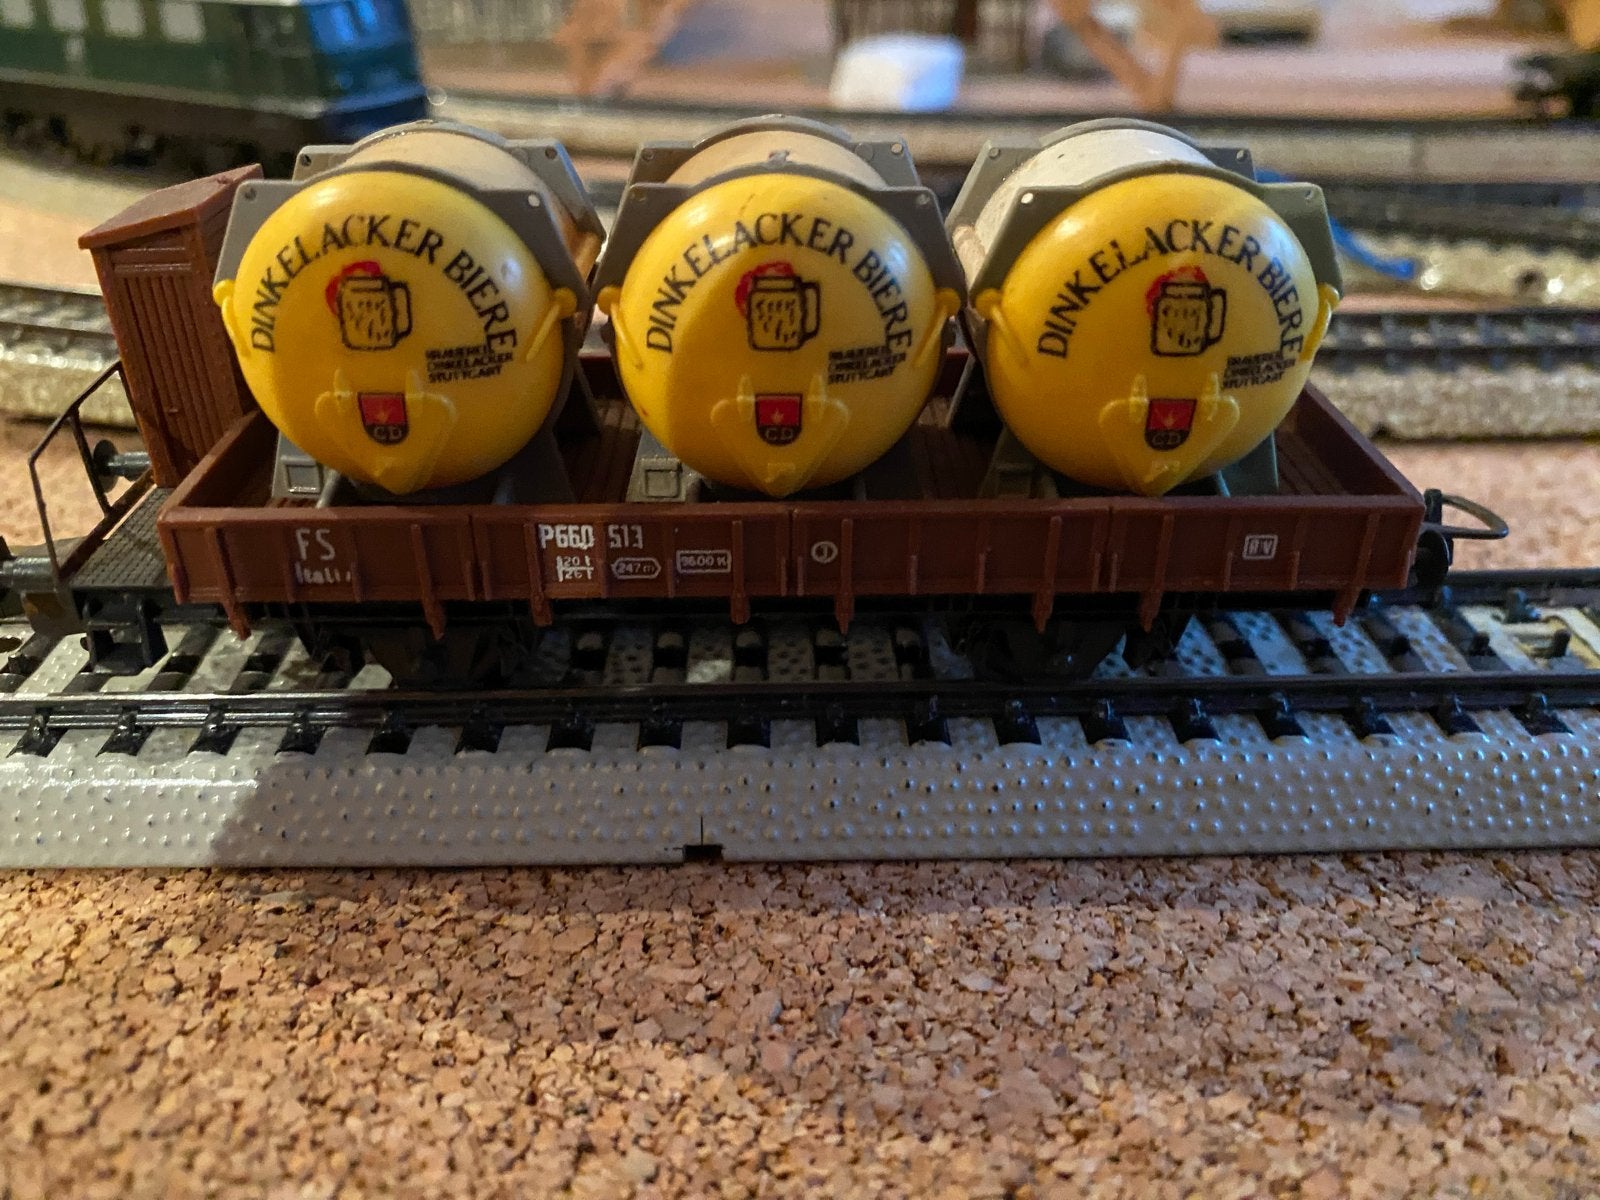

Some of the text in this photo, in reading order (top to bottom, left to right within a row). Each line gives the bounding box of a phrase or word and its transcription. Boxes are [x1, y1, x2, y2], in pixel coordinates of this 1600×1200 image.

[252, 213, 517, 353] DINKELACKER BIERE
[646, 212, 912, 353] DINKELACKER BIERE
[1037, 219, 1304, 359] DINKELACKER BIERE
[295, 528, 336, 560] FS
[608, 524, 643, 548] 513
